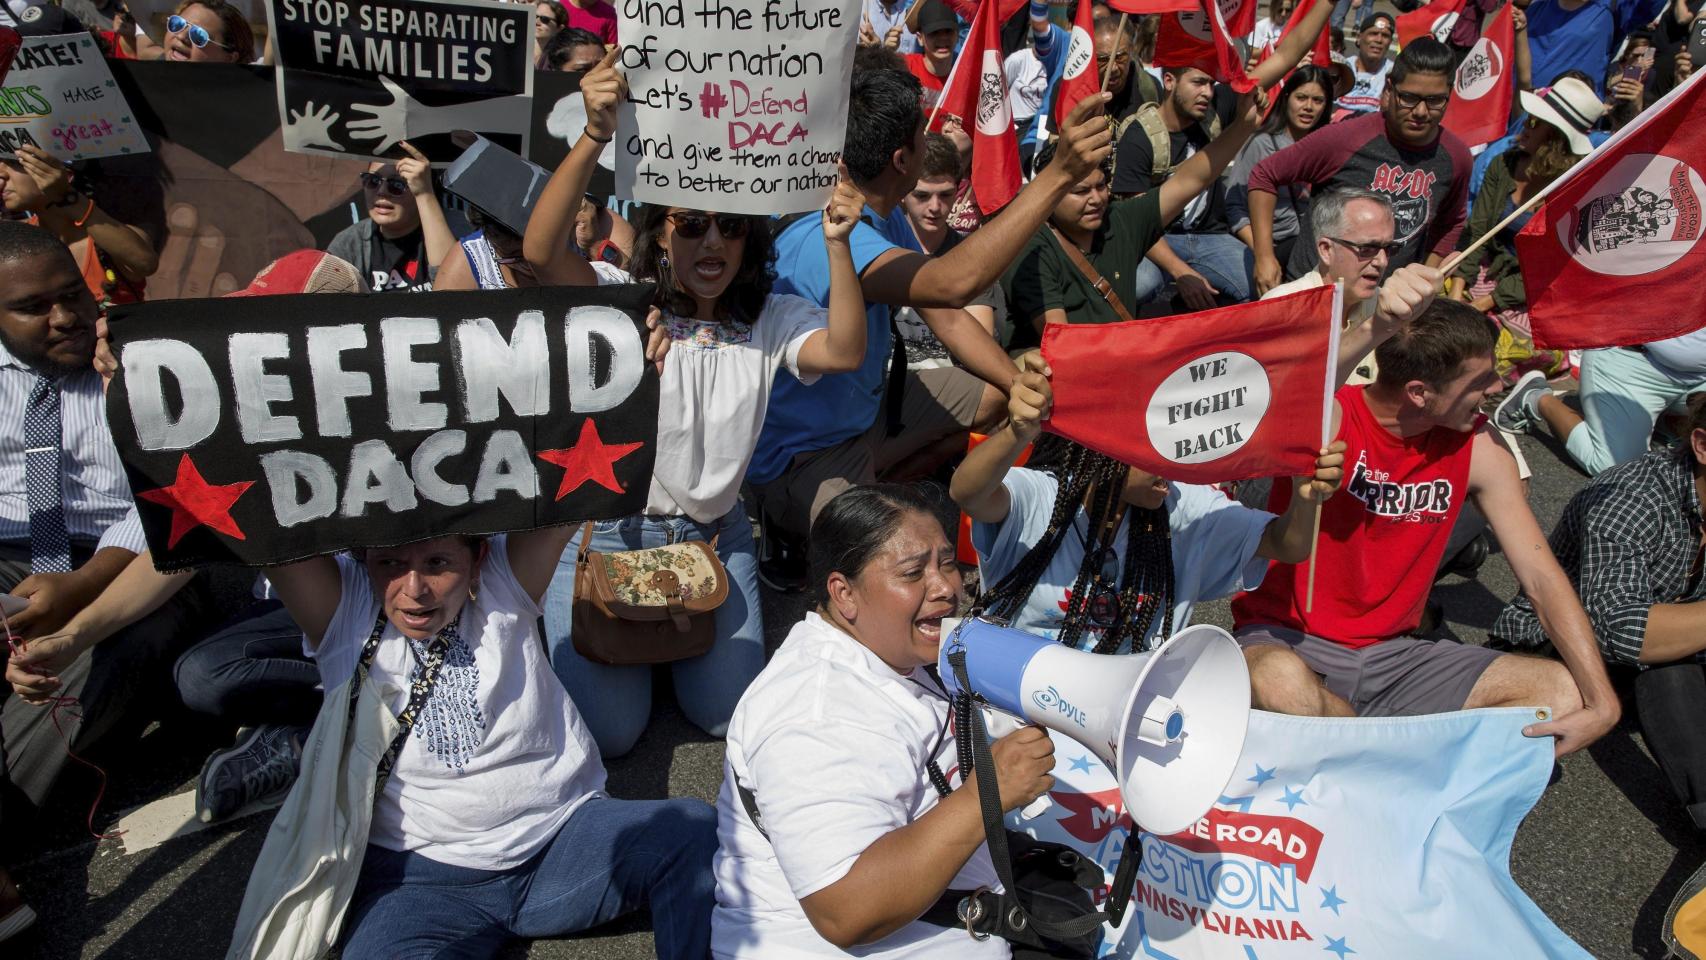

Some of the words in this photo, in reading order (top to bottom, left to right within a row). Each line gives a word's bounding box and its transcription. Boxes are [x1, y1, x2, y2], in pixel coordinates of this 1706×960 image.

[283, 0, 349, 27] STOP
[360, 5, 516, 44] SEPARATING
[624, 0, 684, 28] and
[695, 0, 753, 30] the
[762, 1, 842, 32] future
[313, 30, 492, 82] FAMILIES
[621, 35, 658, 70] of
[665, 48, 723, 74] our
[728, 44, 823, 77] nation
[63, 86, 105, 104] MAKE
[624, 72, 693, 111] Let's
[52, 118, 113, 151] great
[627, 133, 674, 159] and
[684, 142, 723, 170] give
[729, 146, 781, 168] them
[788, 153, 798, 166] a
[728, 121, 808, 150] DACA
[640, 164, 669, 187] to
[678, 169, 745, 193] better
[750, 178, 783, 193] our
[1370, 162, 1437, 199] AC/DC
[1677, 171, 1689, 196] MAKE
[1687, 194, 1698, 212] THE
[1685, 213, 1698, 239] ROAD
[122, 305, 644, 451] DEFEND
[1189, 358, 1228, 383] WE
[1168, 386, 1248, 425] FIGHT
[1174, 422, 1243, 459] BACK
[259, 428, 541, 528] DACA
[1216, 823, 1308, 860] ROAD
[1096, 826, 1300, 912] ACTION
[1093, 879, 1314, 941] PNNSYLVANIA
